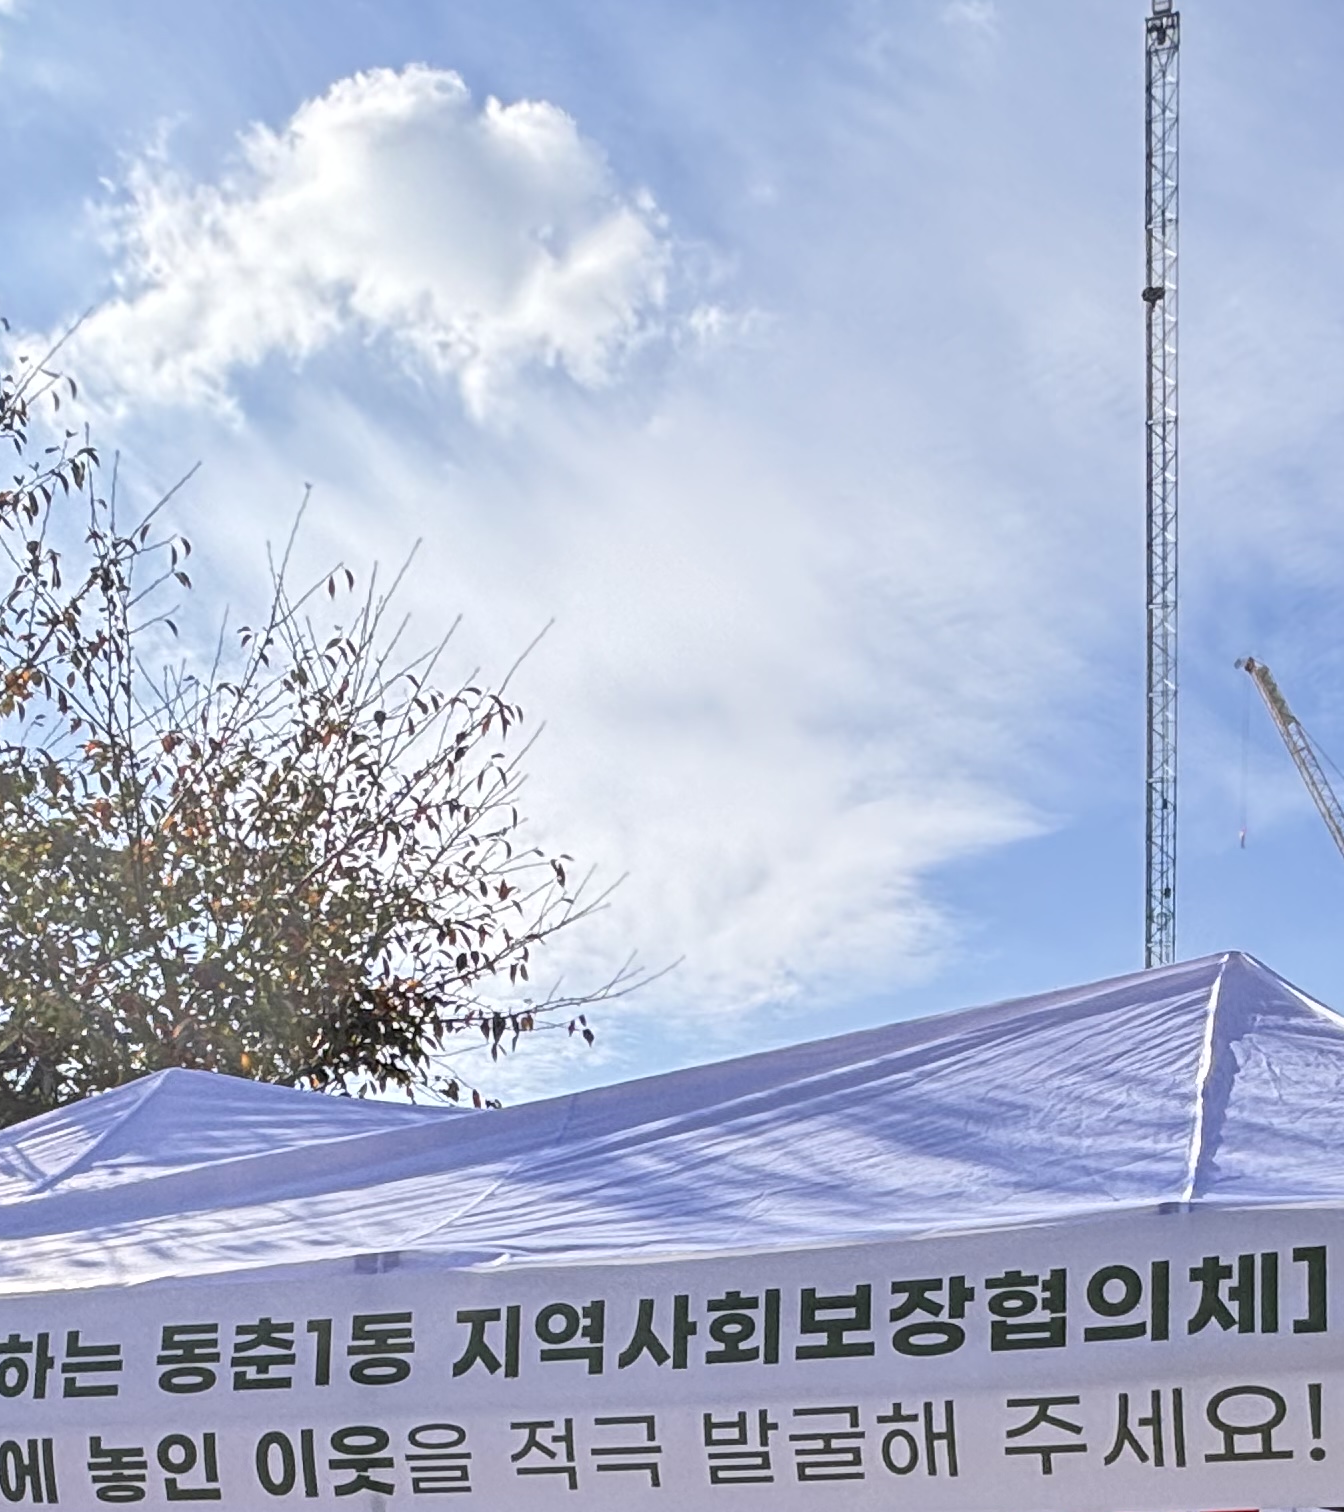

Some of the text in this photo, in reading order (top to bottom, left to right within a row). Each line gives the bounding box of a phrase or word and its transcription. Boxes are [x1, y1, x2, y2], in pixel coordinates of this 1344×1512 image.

[156, 1311, 416, 1395] 동춘1동
[452, 1245, 1328, 1379] 지역사회보장협의체]
[87, 1432, 223, 1503] 놓인
[255, 1421, 473, 1499] 이웃을
[508, 1414, 664, 1491] 적극
[702, 1400, 960, 1486] 발굴해
[1004, 1382, 1327, 1477] 주세요!
